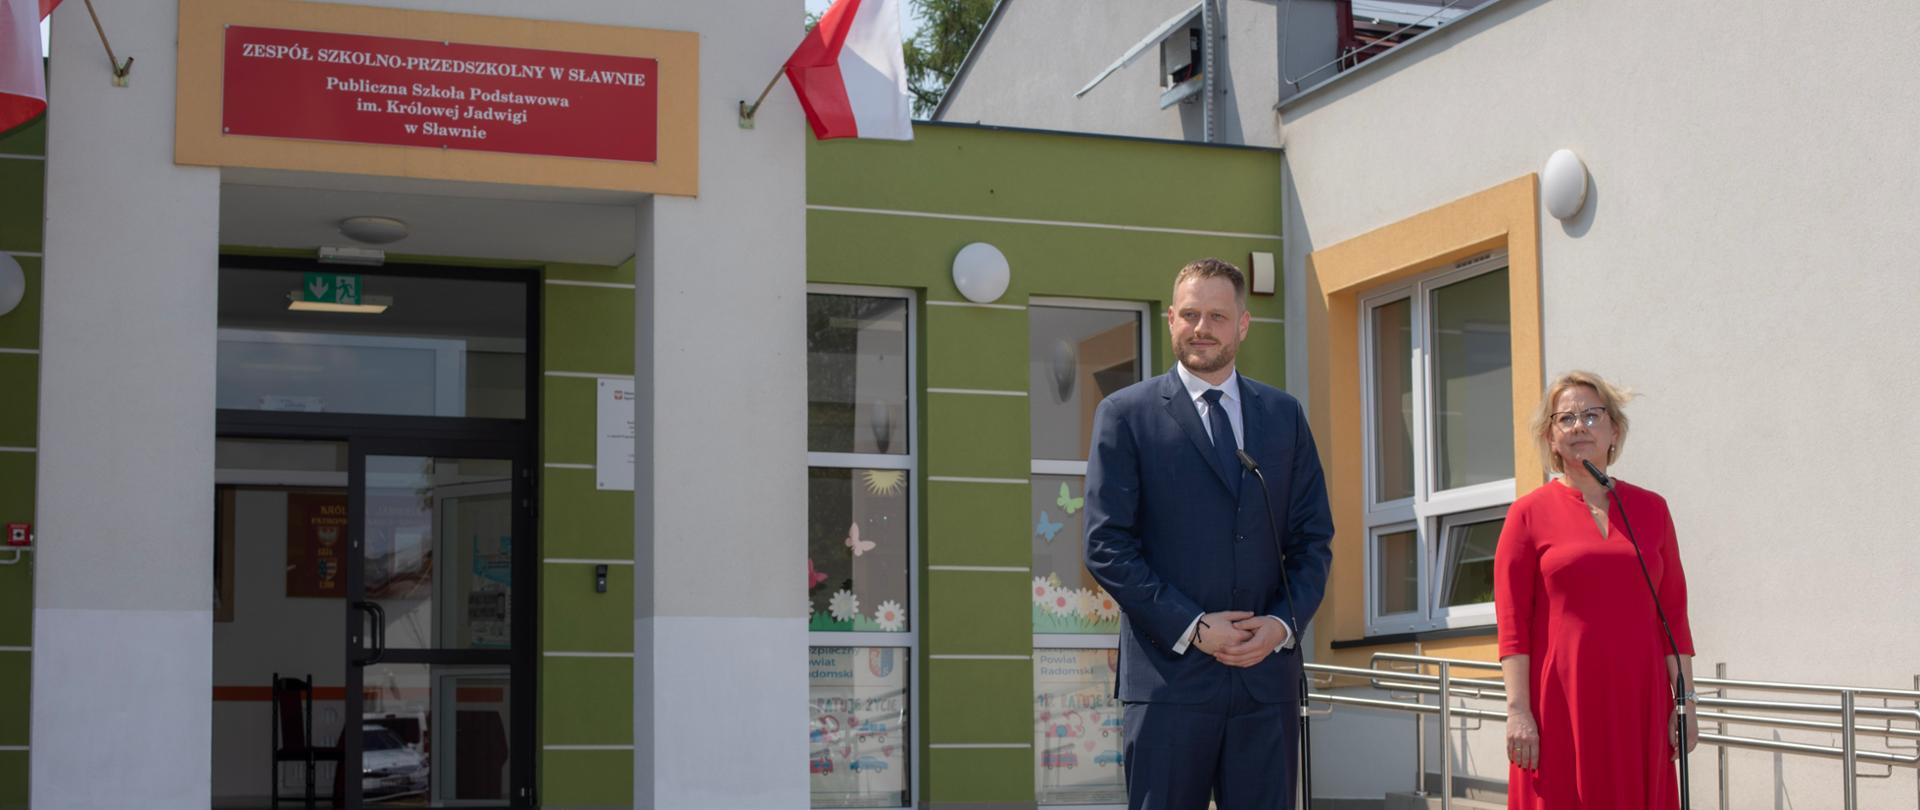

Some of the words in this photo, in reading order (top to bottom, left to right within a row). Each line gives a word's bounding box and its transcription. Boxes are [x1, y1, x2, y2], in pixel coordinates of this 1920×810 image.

[242, 43, 314, 61] ZESPÓŁ
[317, 48, 545, 79] SZKOLNO-PRZEDSZKOLNY
[549, 66, 564, 80] W
[568, 68, 646, 87] SŁAWNIE
[326, 76, 408, 96] Publiczna
[412, 82, 465, 100] Szkoła
[470, 87, 570, 108] Podstawowa
[356, 98, 383, 113] im.
[386, 100, 459, 120] Królowej
[463, 106, 528, 125] Jadwigi
[404, 123, 418, 134] w
[422, 122, 487, 140] Sławnie
[1040, 655, 1077, 665] Powiat
